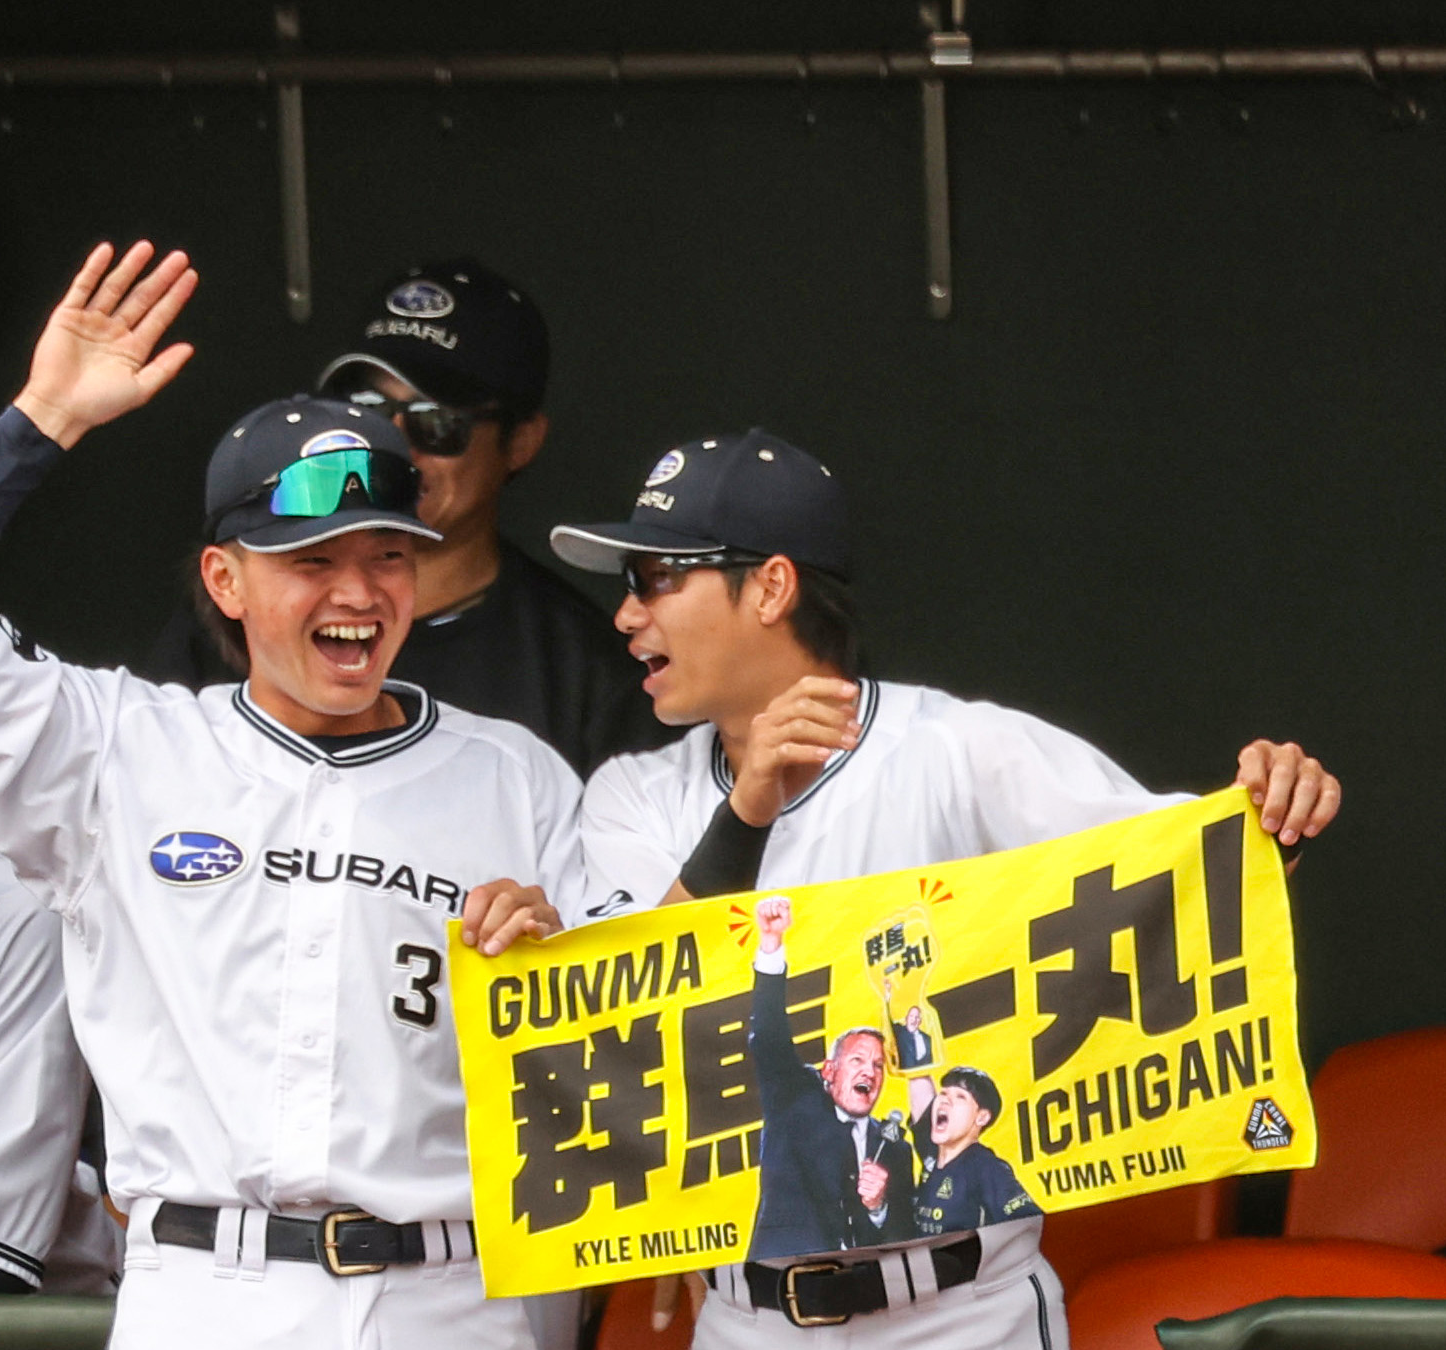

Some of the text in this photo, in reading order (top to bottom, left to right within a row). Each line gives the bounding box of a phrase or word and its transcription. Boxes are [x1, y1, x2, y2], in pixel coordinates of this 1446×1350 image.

[263, 848, 468, 914] SUBAR
[392, 942, 442, 1032] 3
[490, 931, 702, 1040] GUNMA
[1016, 1016, 1275, 1166] ICHIGAN!
[1038, 1145, 1187, 1197] YUMA FUJII
[573, 1222, 739, 1269] KYLE MILLING
